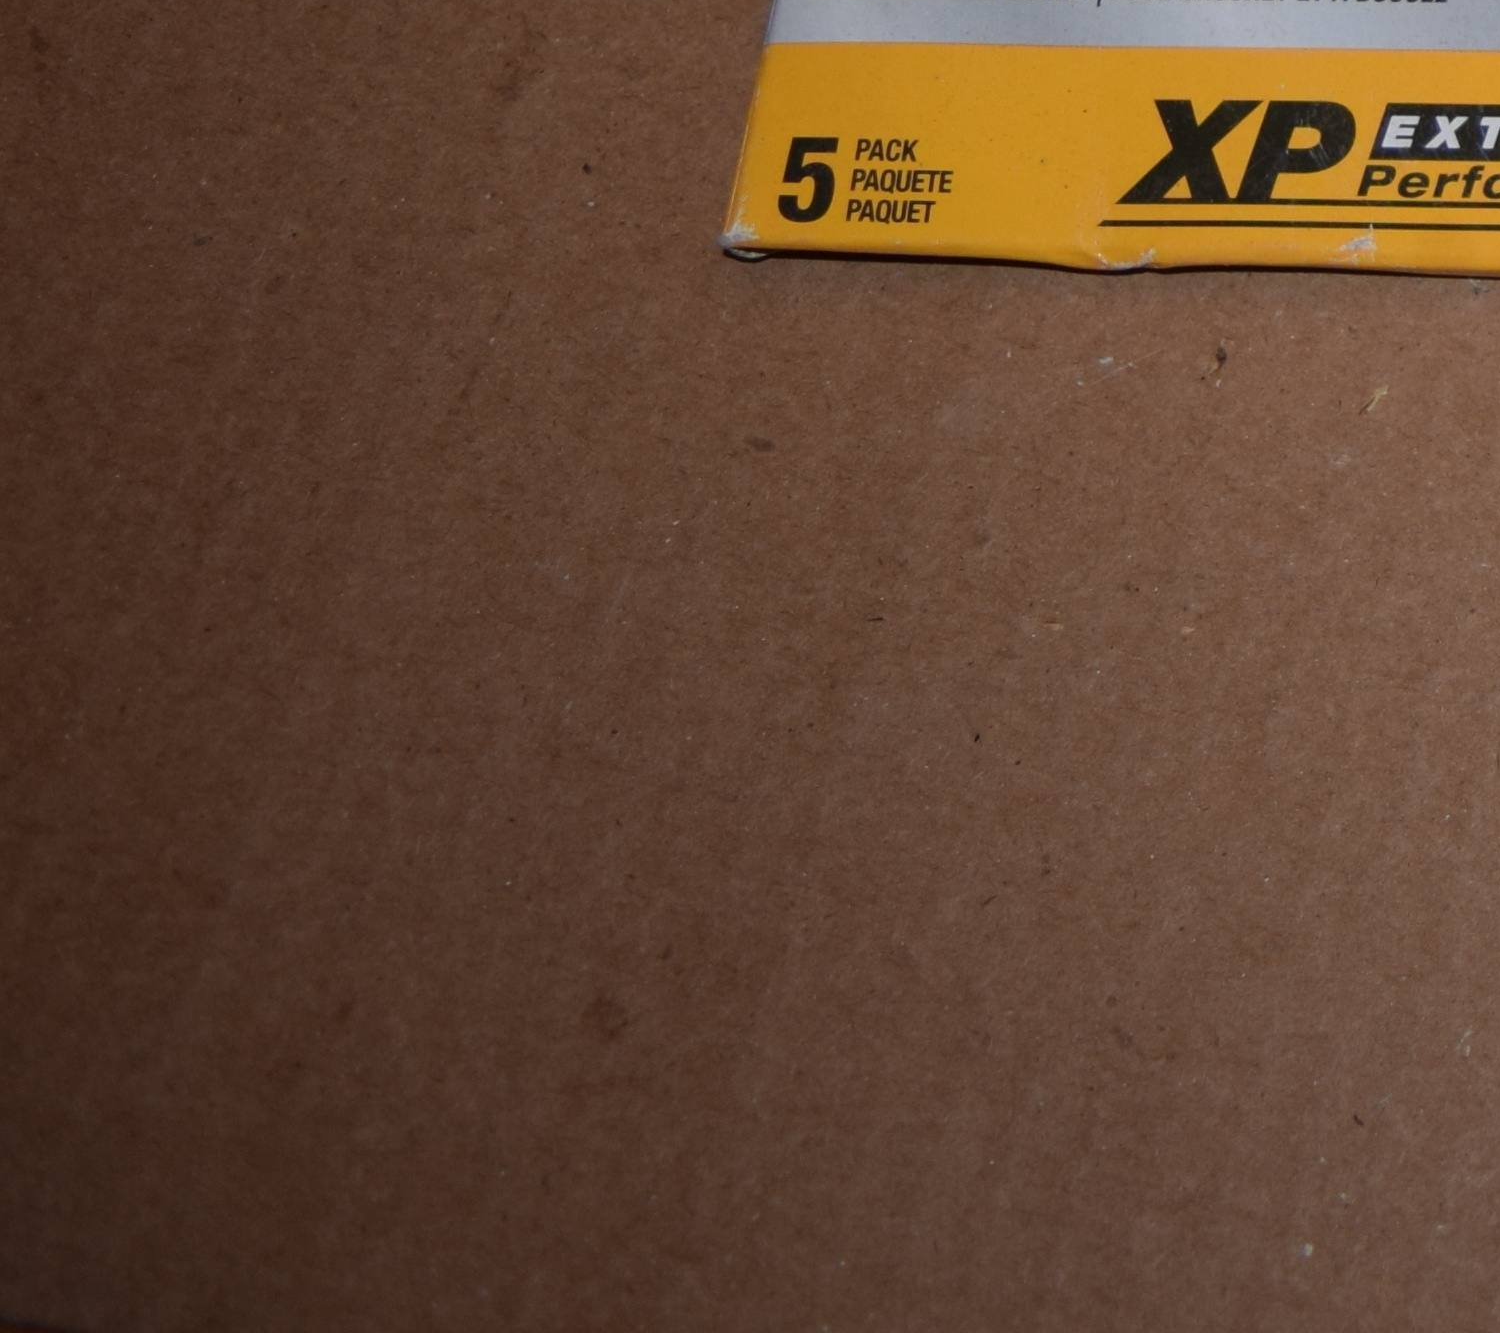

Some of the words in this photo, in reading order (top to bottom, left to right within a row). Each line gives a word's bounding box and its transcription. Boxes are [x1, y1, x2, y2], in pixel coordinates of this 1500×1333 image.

[854, 138, 918, 163] PACK
[1115, 99, 1358, 206] XP
[776, 136, 841, 224] 5
[849, 169, 954, 195] PAQUETE
[845, 199, 936, 224] PAQUET
